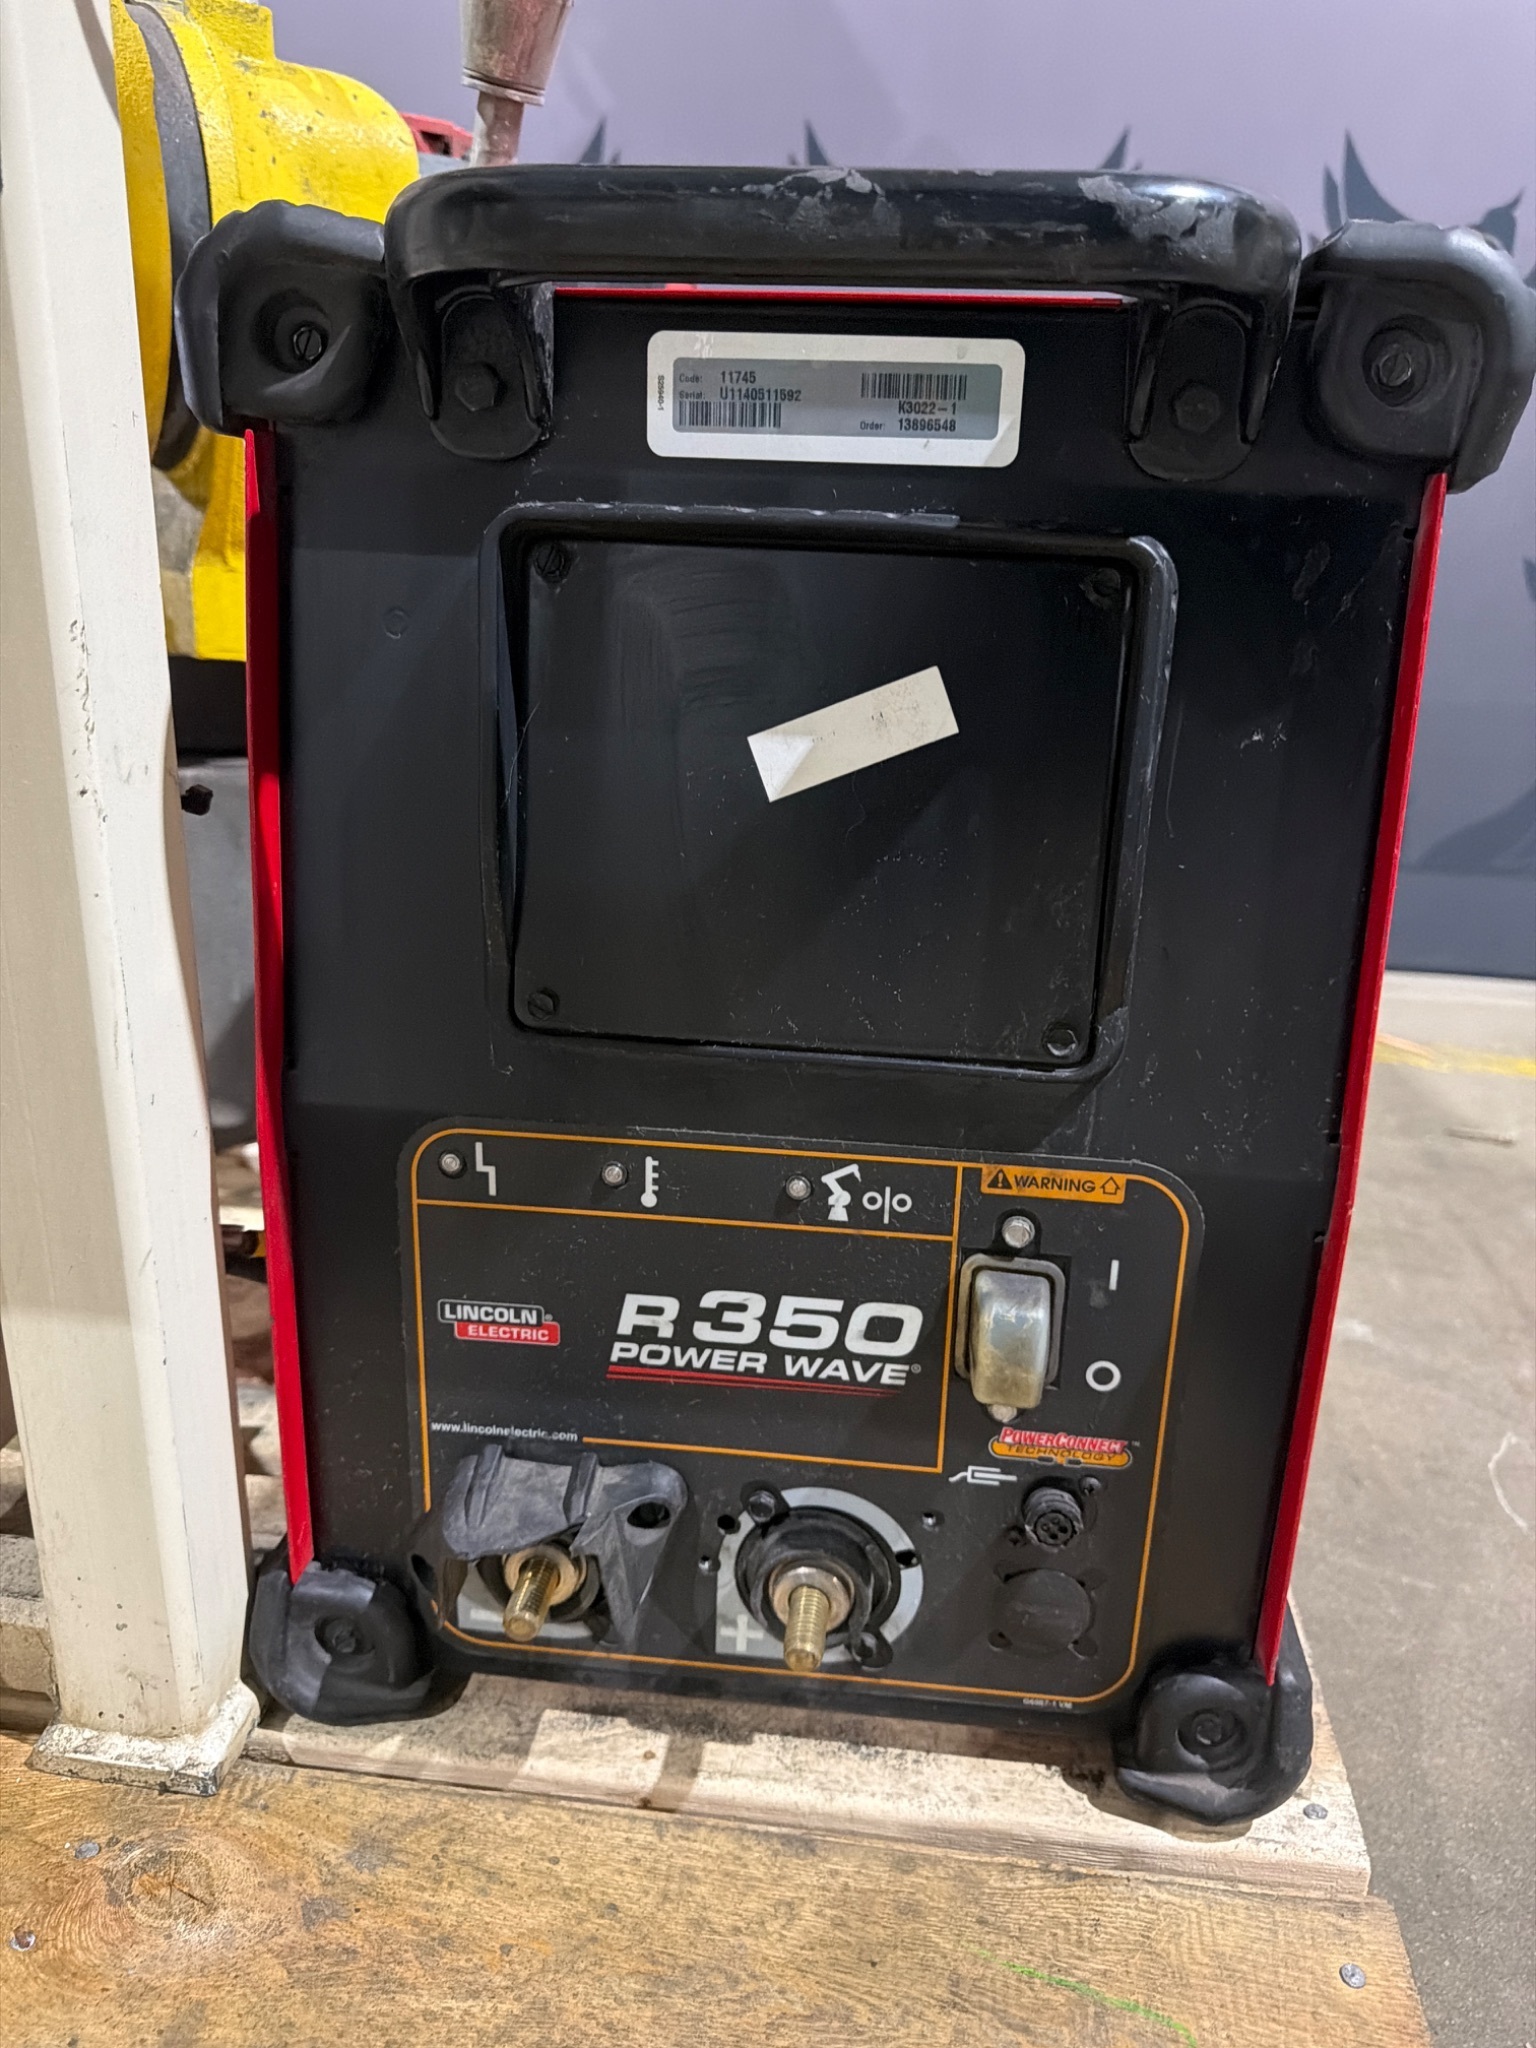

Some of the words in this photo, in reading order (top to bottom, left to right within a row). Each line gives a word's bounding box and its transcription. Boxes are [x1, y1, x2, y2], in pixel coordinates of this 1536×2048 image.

[678, 373, 703, 383] Code:
[720, 371, 757, 384] 11745
[678, 390, 706, 400] Serial:
[719, 387, 802, 402] U1140511592
[898, 401, 957, 415] K3022-1
[859, 420, 886, 431] Order:
[898, 418, 956, 432] 13896548
[1014, 1174, 1096, 1193] WARNING
[616, 1293, 680, 1338] R
[692, 1290, 924, 1357] 350
[467, 1324, 550, 1342] ELECTRIC
[610, 1341, 768, 1374] POWER
[431, 1420, 578, 1442] www.lincolnelectric.com
[1007, 1443, 1117, 1462] TECHNOLOGY
